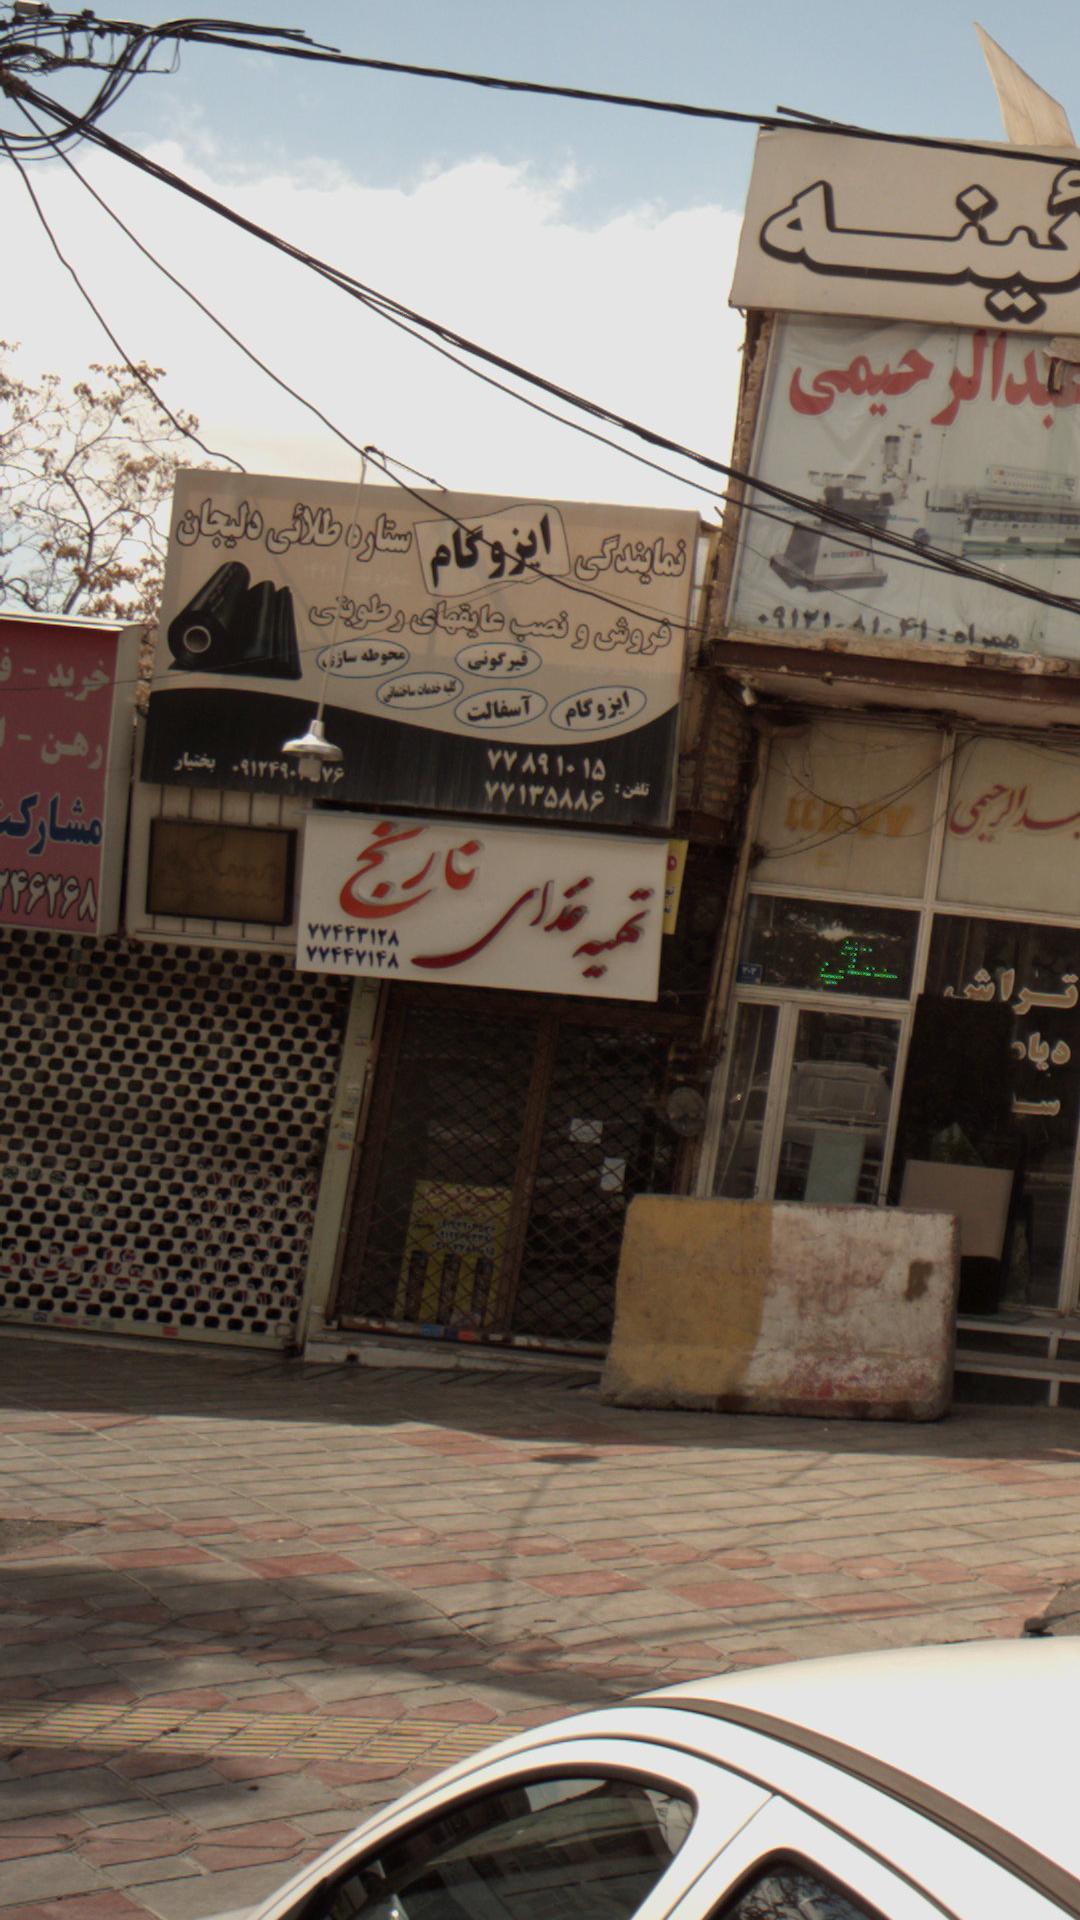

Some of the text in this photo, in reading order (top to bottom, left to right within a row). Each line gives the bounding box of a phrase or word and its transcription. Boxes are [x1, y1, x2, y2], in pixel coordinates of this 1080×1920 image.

[176, 499, 687, 587] نمایندگی ایزوگام ستاره طلائی دلیجان
[308, 594, 672, 655] فروش و نصب عایقهای رطوبتی
[321, 648, 406, 670] محوطه سازی
[47, 659, 109, 701] خرید
[466, 696, 532, 722] آسفالت
[40, 730, 102, 769] رهن
[173, 751, 217, 774] بختیار
[484, 780, 606, 813] ۷۷۱۳۵۸۸۶
[340, 821, 481, 919] نارنج
[410, 875, 594, 970] غذای
[572, 887, 655, 980] تهیه
[306, 945, 400, 969] ۷۷۴۴۷۱۴۸
